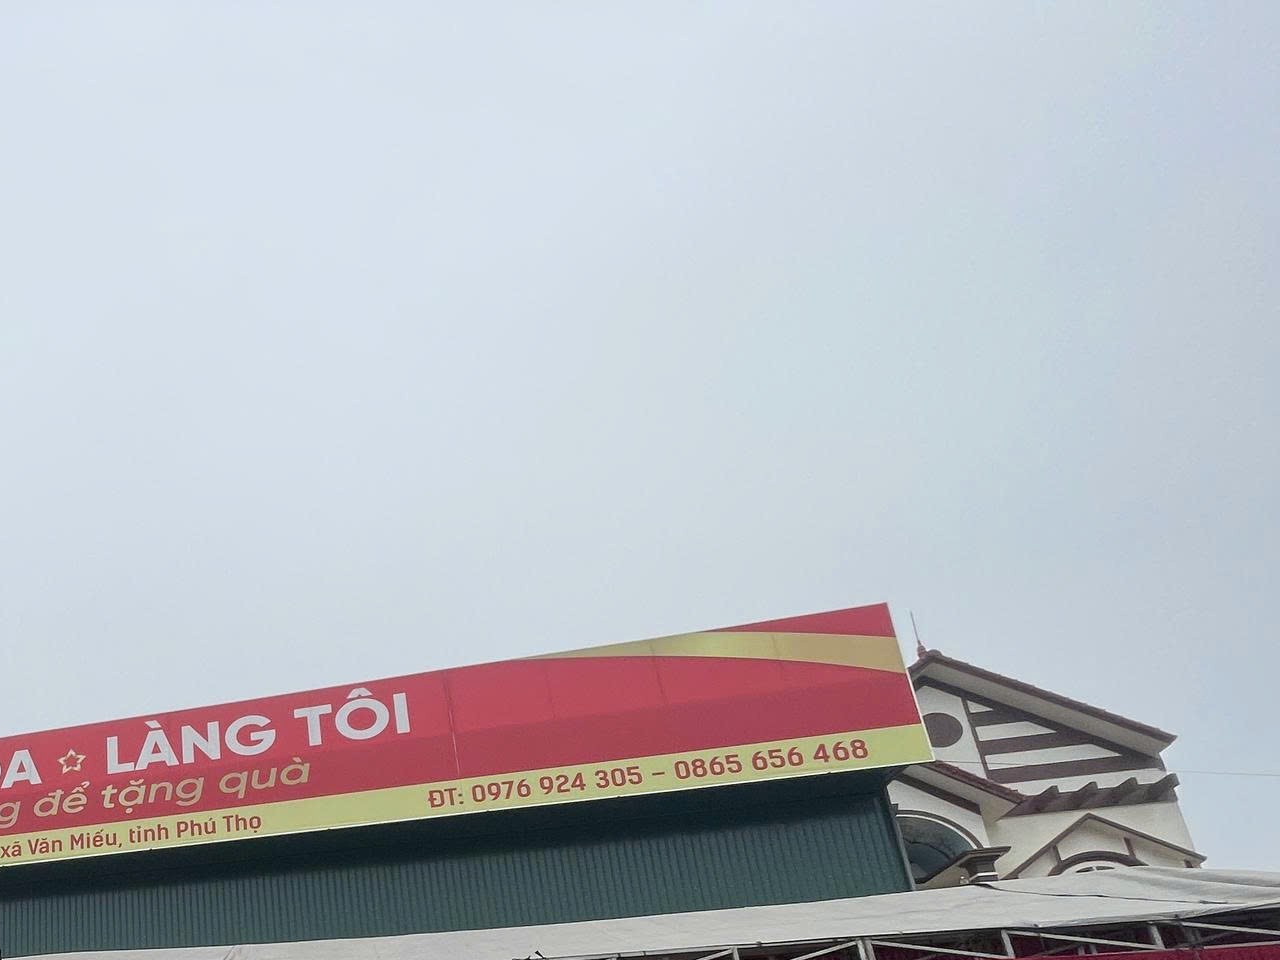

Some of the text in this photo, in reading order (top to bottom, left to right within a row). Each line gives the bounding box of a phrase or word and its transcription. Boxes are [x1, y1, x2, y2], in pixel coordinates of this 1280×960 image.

[106, 719, 277, 775] LÀNG
[293, 687, 411, 747] TÔI
[32, 780, 91, 817] để
[101, 775, 205, 814] tặng
[218, 756, 310, 799] quà
[427, 787, 465, 808] ĐT:
[471, 778, 532, 803] 0976
[539, 772, 587, 795] 924
[594, 766, 644, 789] 305
[674, 754, 743, 780] 0865
[751, 746, 805, 771] 656
[813, 739, 869, 763] 468
[0, 840, 23, 859] xã
[27, 836, 64, 855] Văn
[70, 828, 123, 851] Miếu,
[129, 823, 169, 844] tỉnh
[176, 817, 217, 839] Phú
[222, 814, 262, 834] Thọ
